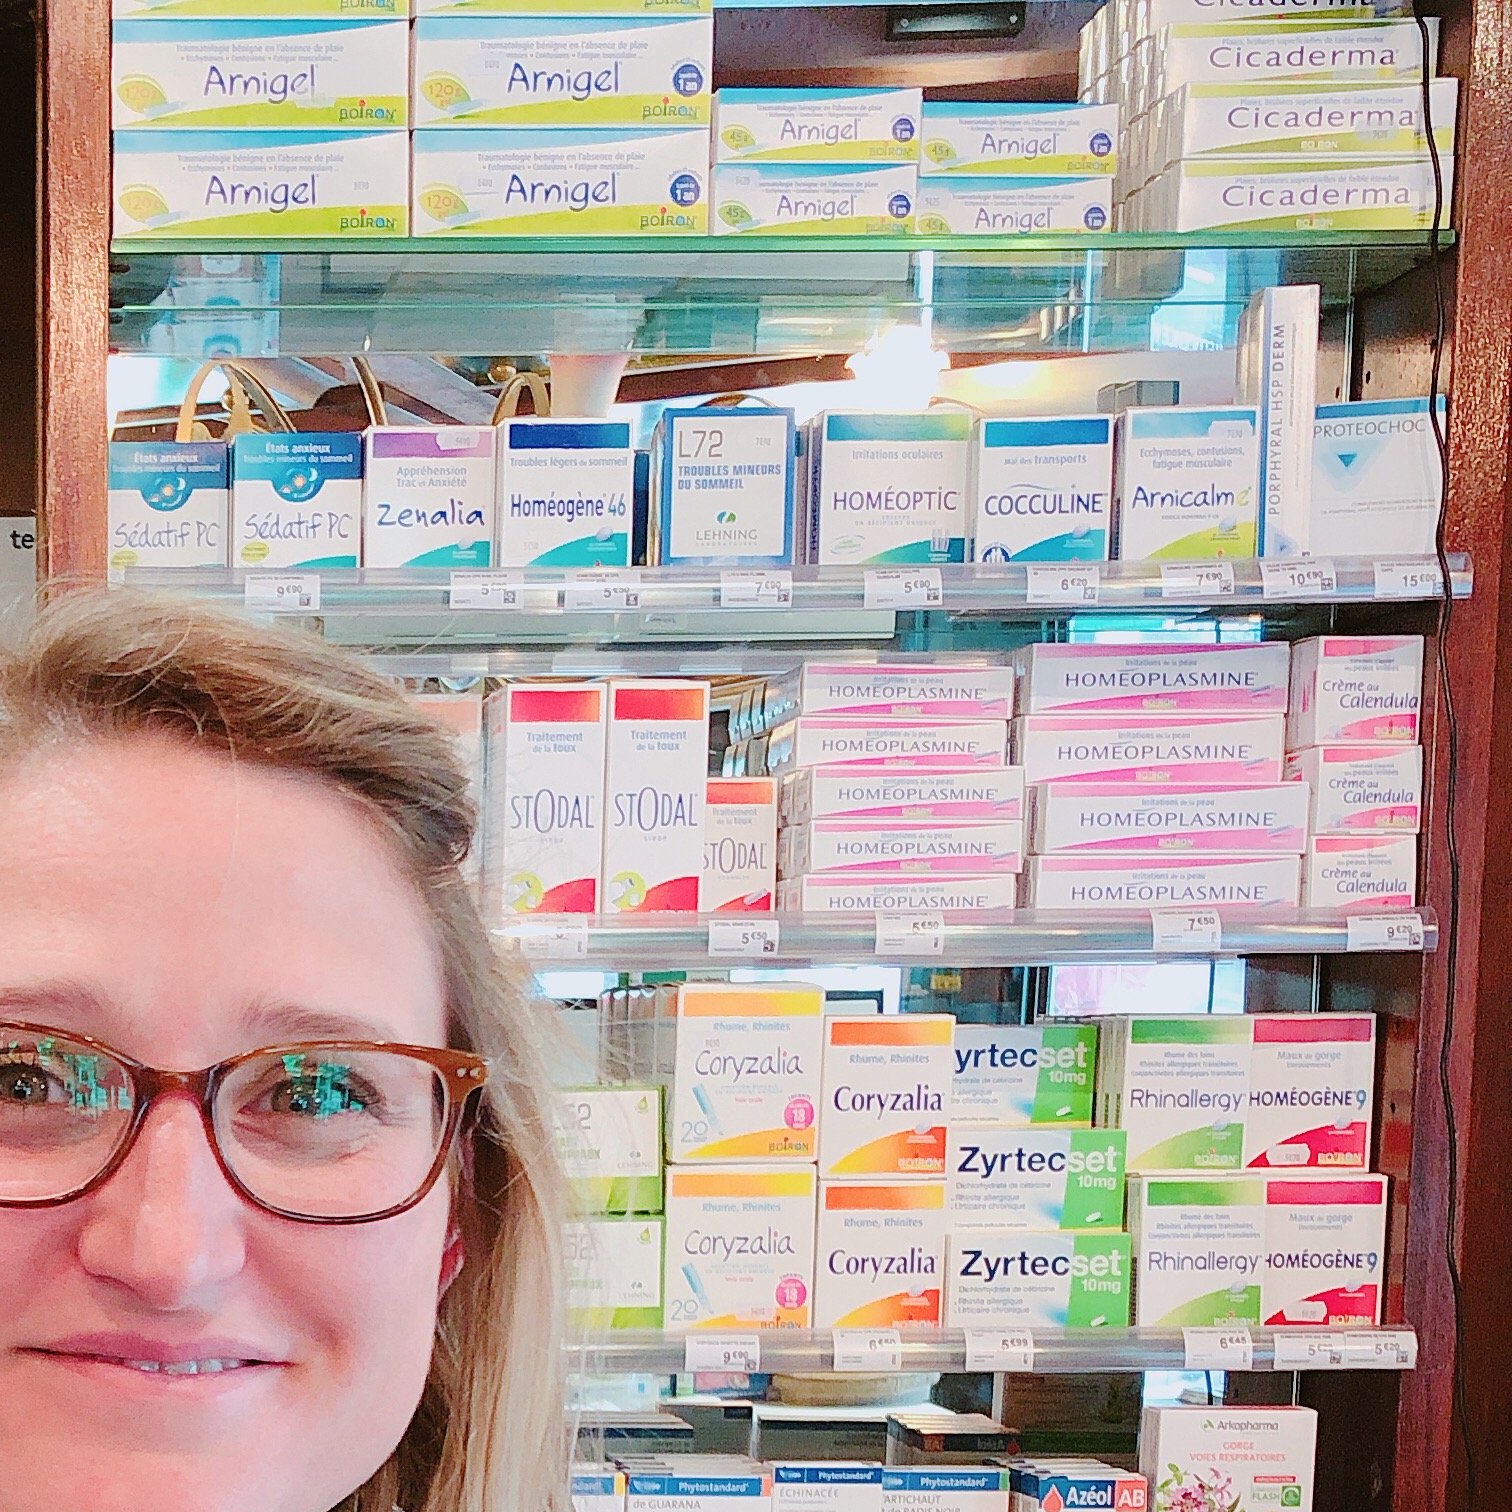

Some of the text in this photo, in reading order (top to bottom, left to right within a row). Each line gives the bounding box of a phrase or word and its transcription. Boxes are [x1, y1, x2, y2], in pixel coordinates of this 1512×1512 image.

[1209, 45, 1396, 69] Cicaderma
[203, 63, 315, 105] Arnigel
[507, 61, 619, 101] Arnigel
[1227, 105, 1415, 130] Cicaderma
[780, 117, 858, 145] Arnigel
[980, 133, 1058, 160] Arnigel
[205, 173, 316, 213] Arnigel
[504, 172, 616, 211] Arnigel
[1274, 324, 1286, 373] DERM
[1313, 418, 1426, 439] PROTEOCHOC
[677, 429, 724, 459] L72
[902, 449, 943, 460] oculaires
[510, 456, 548, 467] Troubles
[588, 456, 628, 467] sommeil
[678, 463, 781, 476] TROUBLES MINEURS
[1034, 454, 1087, 466] transports
[1268, 416, 1281, 516] PORPHYRAL
[396, 465, 467, 477] Appréhension
[677, 478, 744, 490] DU SOMMEIL
[376, 498, 485, 529] Zenalia
[510, 491, 627, 523] Homéogène 46
[984, 491, 1104, 516] COCCULINE
[243, 511, 353, 541] Sédatif PC
[695, 529, 758, 541] LEHNING
[1322, 679, 1380, 694] Crème au
[1339, 692, 1419, 709] Calendula
[630, 729, 687, 741] Traitement
[613, 786, 698, 832] STODAL
[752, 1021, 791, 1033] Rhinites
[694, 1046, 804, 1082] Coryzalia
[849, 1053, 930, 1065] Rhume, Rhinites
[953, 1041, 1087, 1074] yrtecset
[1049, 1070, 1087, 1085] 10mg
[833, 1083, 943, 1120] Coryzalia
[1129, 1088, 1242, 1112] Rhinallergy
[1249, 1085, 1367, 1110] HOMÉOGÈNE 9
[957, 1145, 1118, 1179] Zyrtecset
[1077, 1174, 1117, 1191] 10mg
[1217, 1420, 1279, 1432] Arkopharma
[1223, 1442, 1255, 1450] GORGE
[1189, 1453, 1287, 1462] VOIES RESPIRATOIRES
[678, 1481, 747, 1494] Phytostandard
[779, 1485, 840, 1498] ÉCHINACÉE
[920, 1476, 986, 1488] Phytostandard
[632, 1499, 702, 1510] de GUARANA
[1065, 1486, 1145, 1507] Azéol AB
